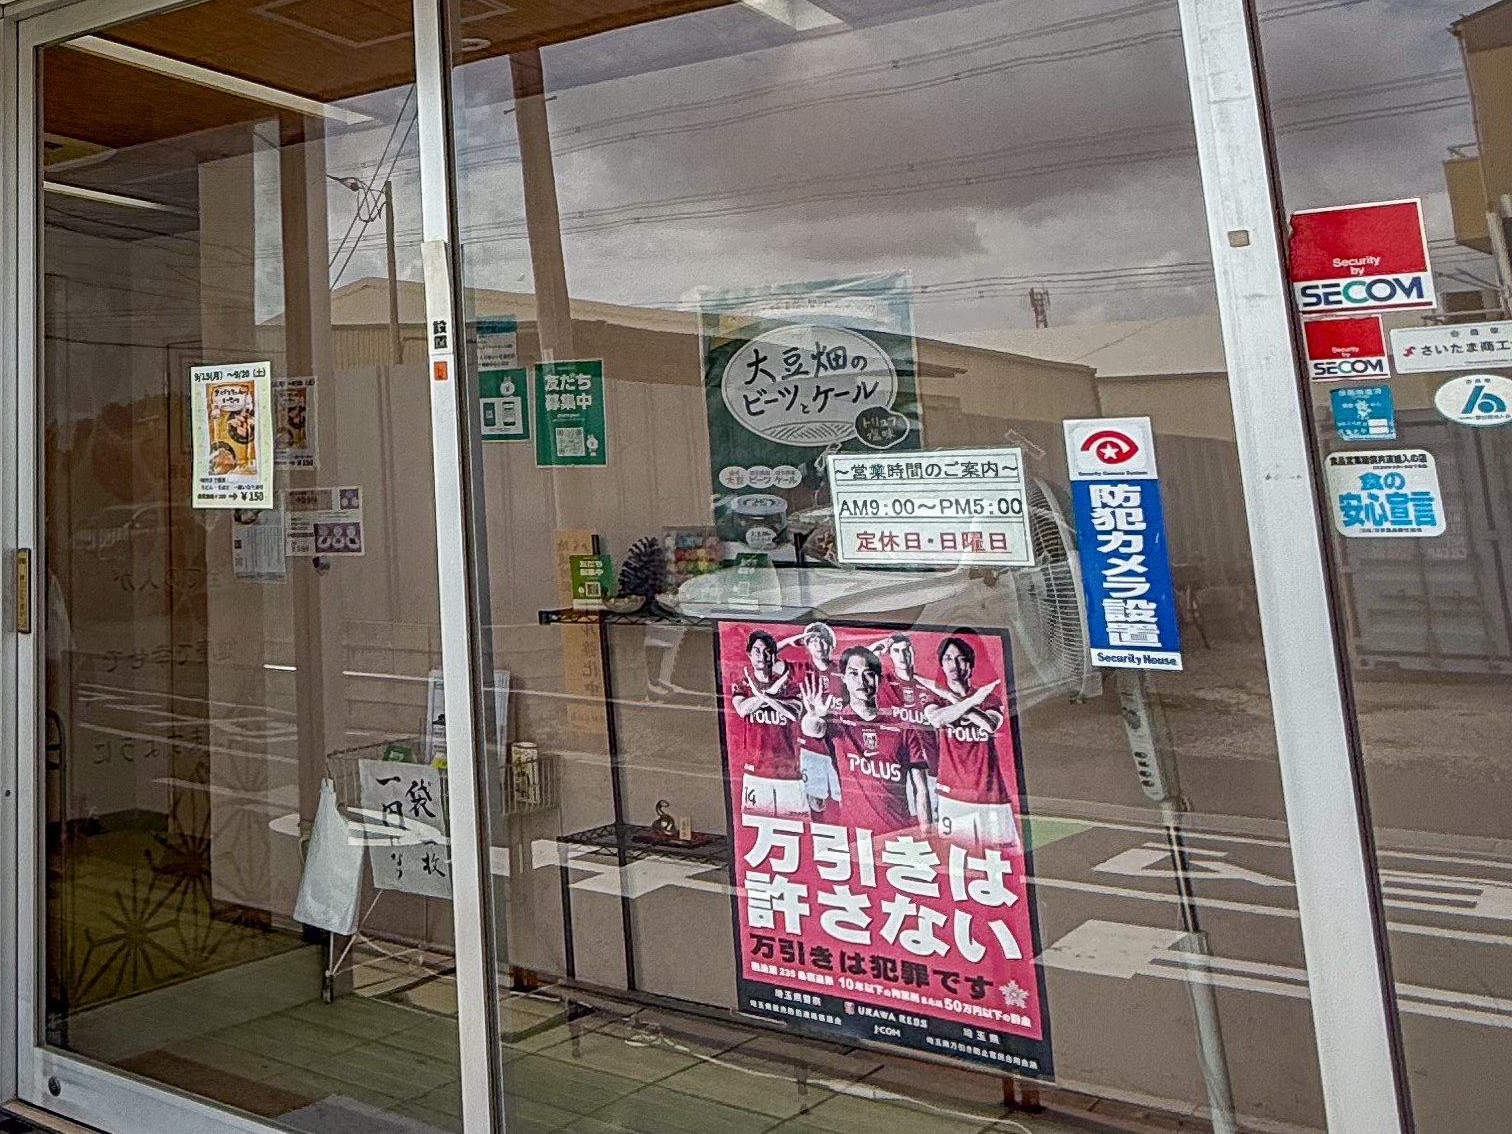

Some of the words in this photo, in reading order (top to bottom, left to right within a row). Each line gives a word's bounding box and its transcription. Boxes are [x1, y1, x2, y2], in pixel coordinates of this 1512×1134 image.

[1333, 256, 1381, 268] Security
[1350, 266, 1365, 276] by
[1300, 276, 1425, 307] SECOM
[1421, 340, 1512, 356] さいたま商工
[744, 341, 868, 385] 大豆畑の
[1314, 359, 1384, 375] SECOM
[544, 372, 592, 392] 友だち
[544, 393, 592, 412] 募集中
[742, 380, 880, 416] ビーツとケール
[1358, 472, 1406, 491] 食の
[1338, 492, 1437, 527] 安心宣言
[856, 530, 1008, 552] 定休日・日曜日
[1089, 484, 1163, 647] 防犯カメラ設置
[1097, 652, 1142, 666] Security
[1143, 656, 1177, 666] House
[847, 753, 902, 782] POLUS
[942, 817, 952, 836] 9
[742, 813, 1020, 908] 万引きは
[744, 871, 1023, 963] 許さない
[749, 932, 995, 1000] 万引きは犯罪です
[857, 1006, 897, 1022] URAWA
[899, 1014, 929, 1029] REDS
